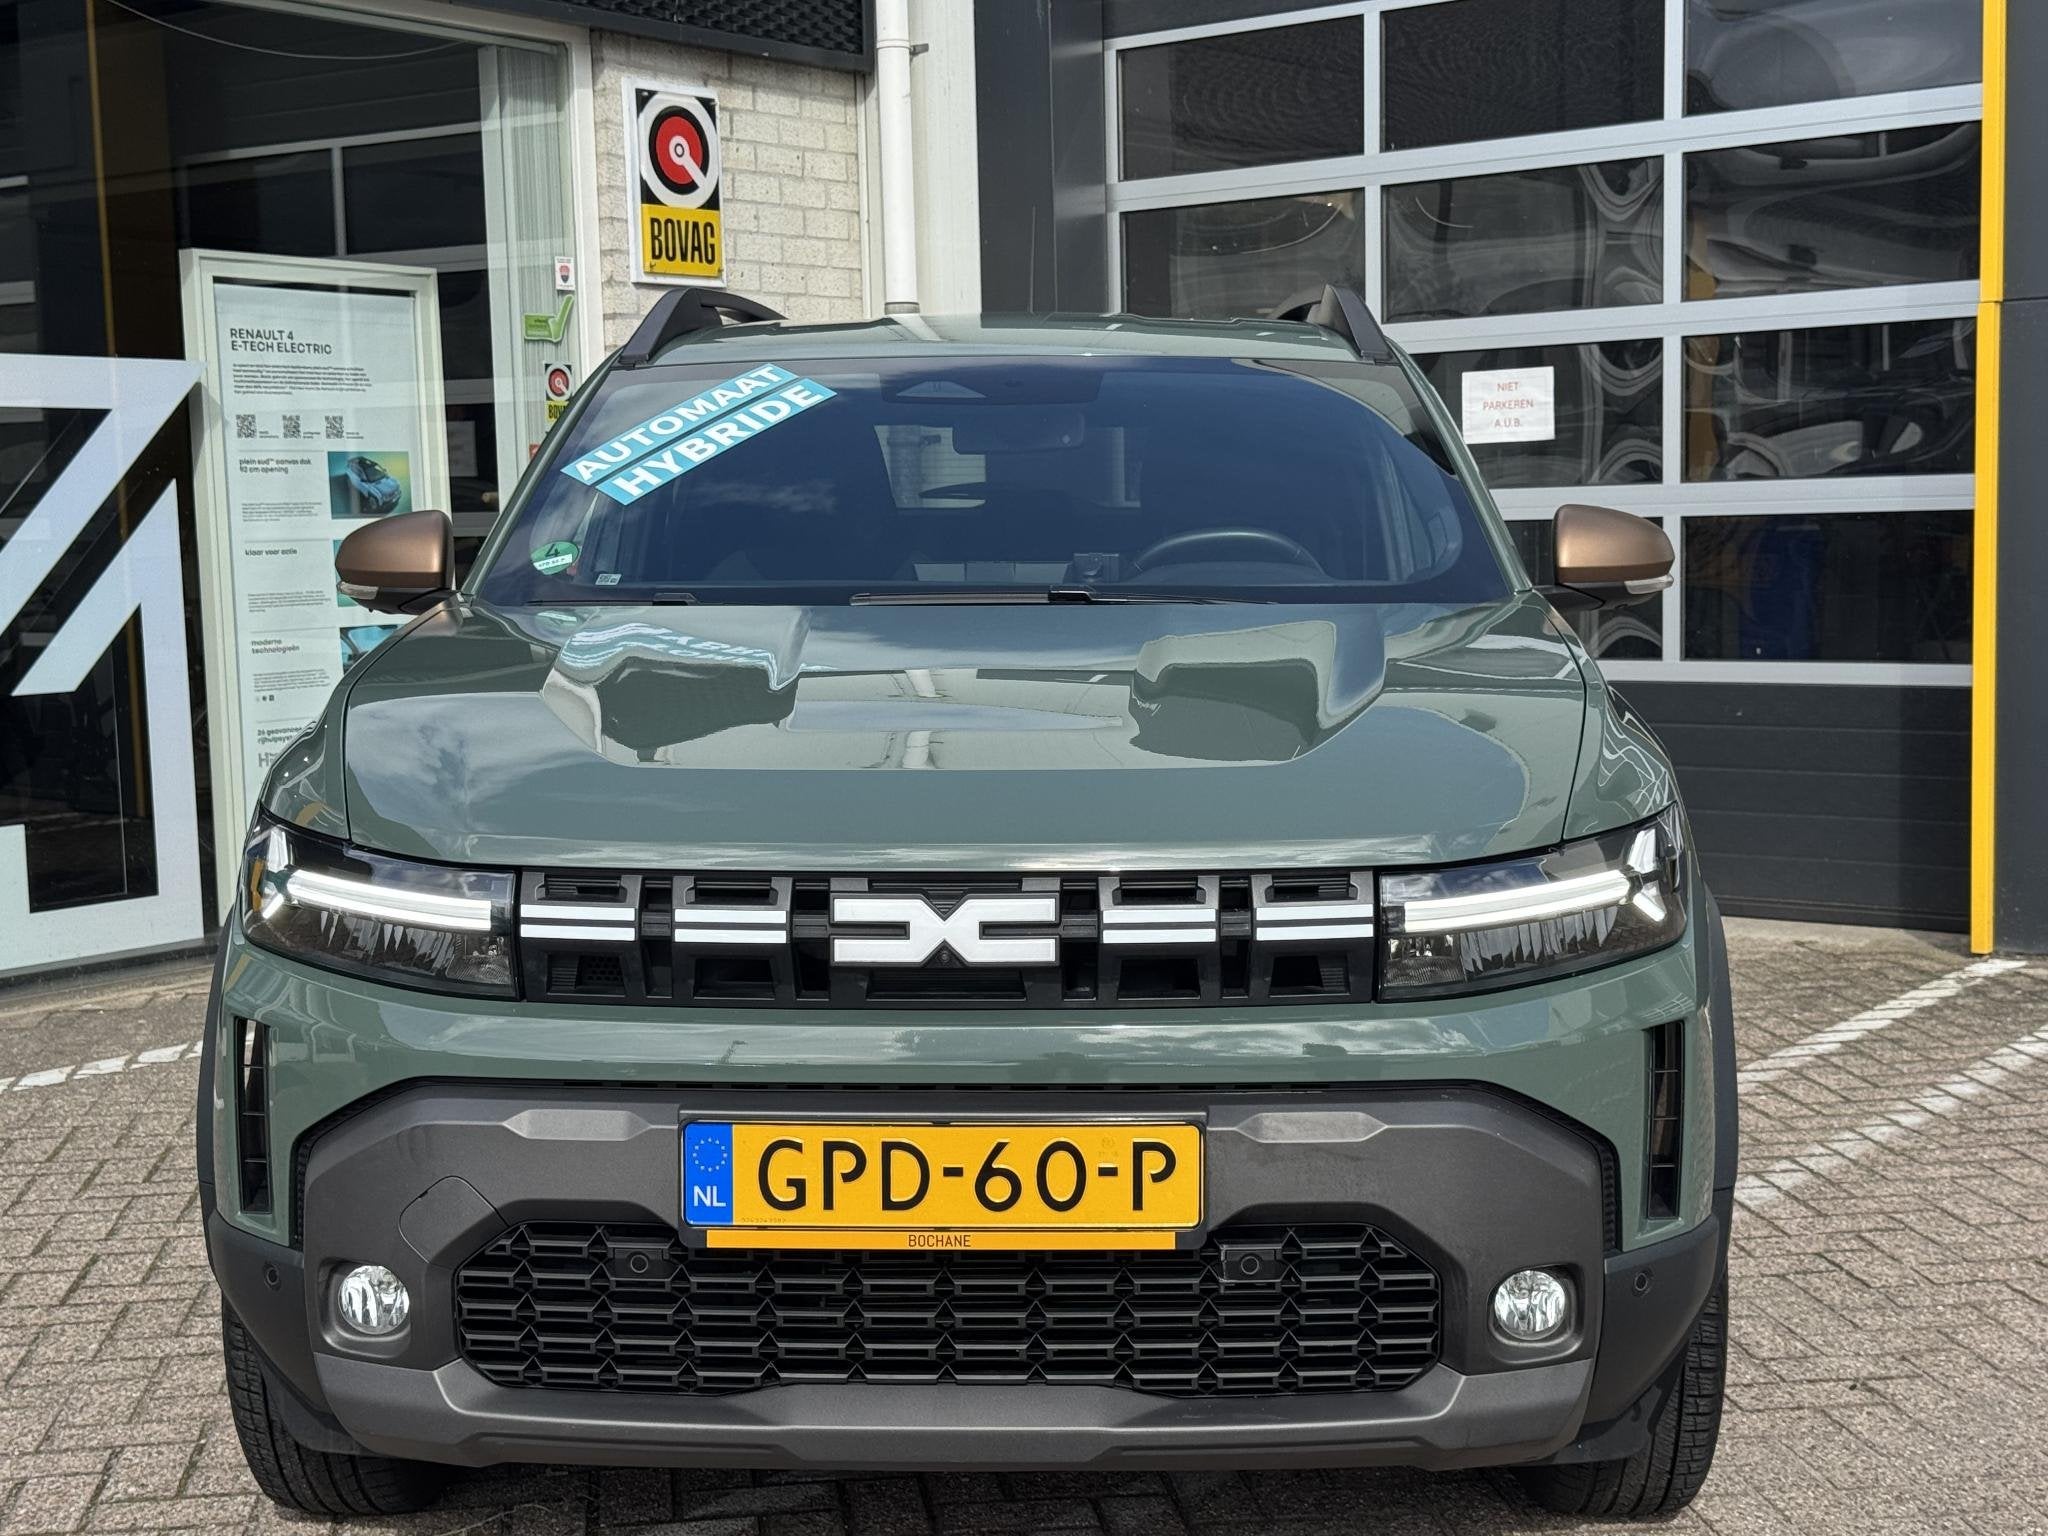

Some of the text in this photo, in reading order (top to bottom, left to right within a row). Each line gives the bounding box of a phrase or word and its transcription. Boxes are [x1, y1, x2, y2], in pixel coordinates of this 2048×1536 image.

[650, 217, 716, 264] BOVAG
[230, 328, 294, 340] RENAULT 4
[231, 340, 332, 355] E-TECH ELECTRIC
[1497, 382, 1519, 392] NIET
[1483, 400, 1534, 410] PARKEREN
[573, 365, 784, 481] AUTOMAAT
[610, 383, 825, 497] HYBRIDE
[261, 466, 288, 475] opening
[545, 543, 560, 557] 4
[758, 1138, 1177, 1212] GPD-60-P
[693, 1185, 726, 1207] NL
[908, 1234, 971, 1248] BOCHANE
